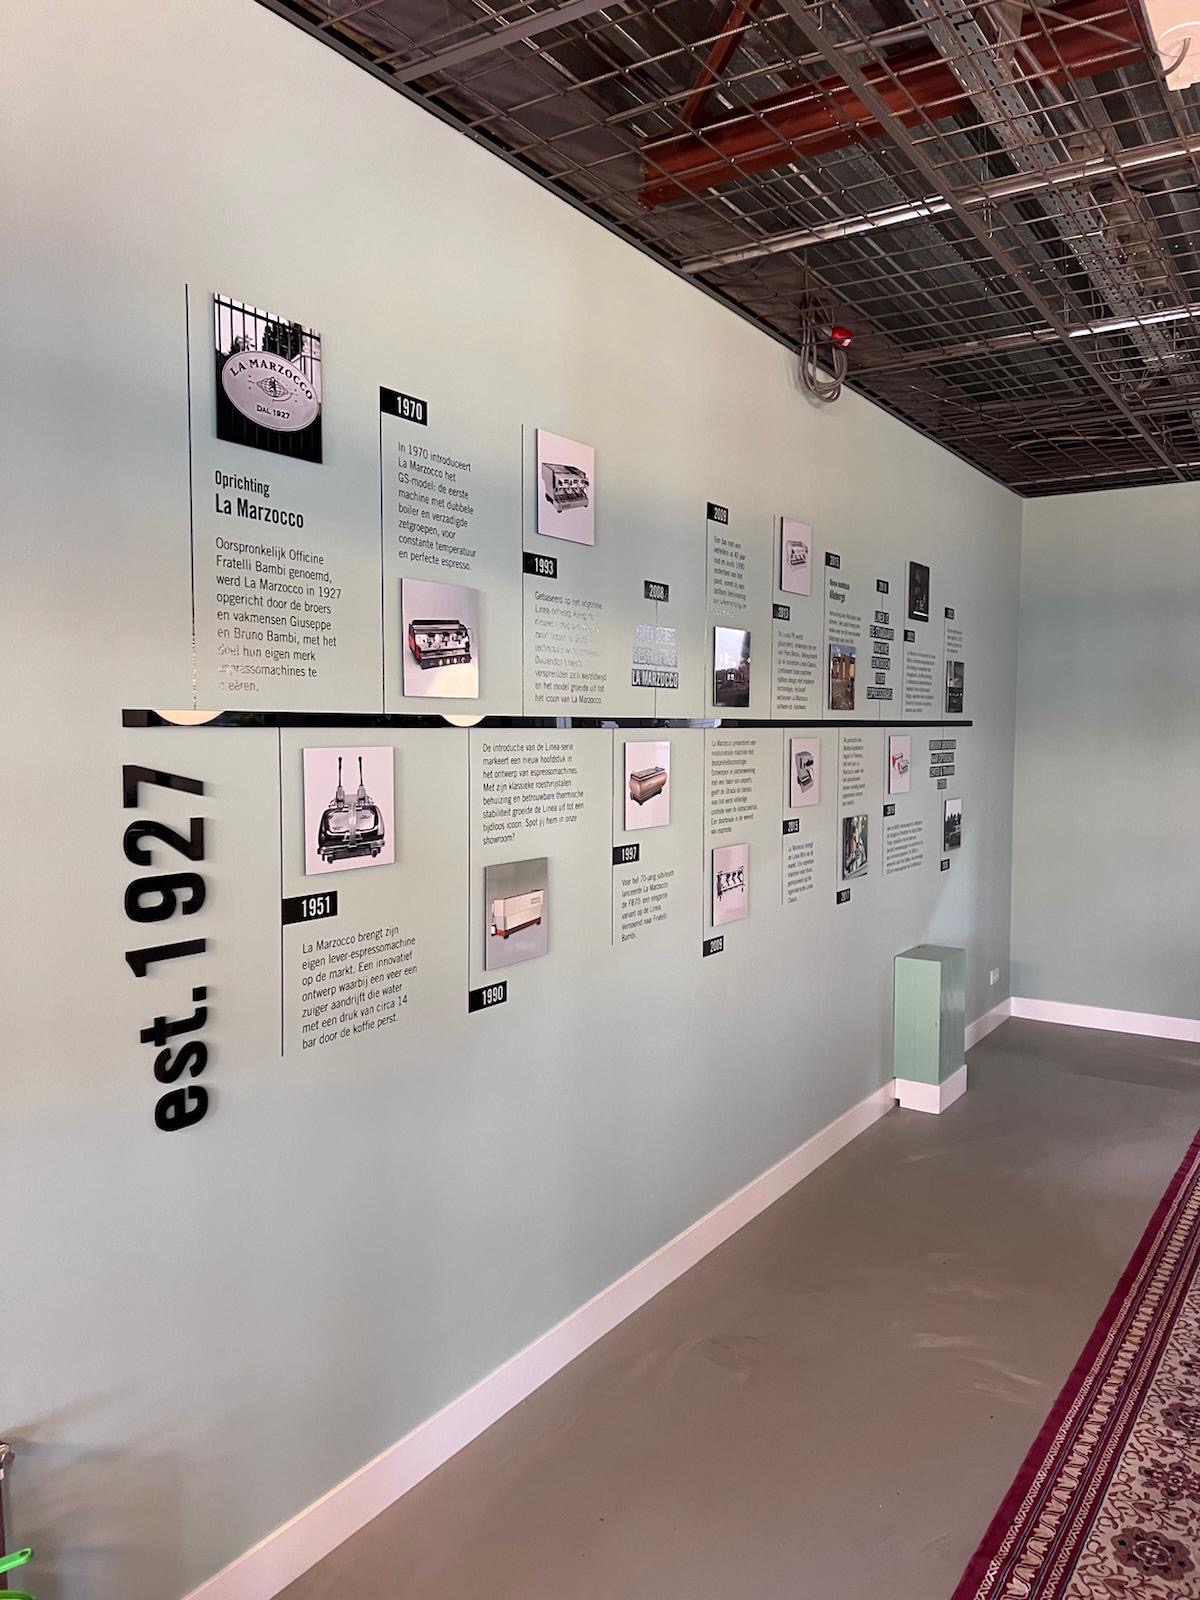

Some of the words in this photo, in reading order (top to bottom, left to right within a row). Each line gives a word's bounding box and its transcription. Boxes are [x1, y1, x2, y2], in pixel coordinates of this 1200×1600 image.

[229, 362, 247, 376] LA
[249, 358, 314, 400] MARZOCCO
[256, 404, 272, 416] DAL
[272, 409, 290, 420] 1927
[396, 396, 423, 421] 1970
[398, 440, 406, 453] In
[408, 444, 428, 460] 1970
[430, 451, 472, 472] introduceert
[398, 456, 408, 469] La
[410, 460, 443, 478] Marzocco
[445, 470, 456, 482] het
[215, 470, 270, 498] Oprichting
[438, 483, 447, 494] de
[448, 488, 469, 500] eerste
[215, 493, 232, 516] La
[237, 497, 304, 528] Marzocco
[398, 489, 430, 504] machine
[432, 498, 445, 508] met
[446, 501, 474, 515] dubbele
[398, 502, 419, 516] boiler
[421, 510, 430, 519] en
[432, 513, 468, 528] verzadigde
[442, 530, 456, 539] voor
[216, 536, 286, 561] Oorspronkelijk
[289, 549, 324, 565] Officine
[398, 536, 434, 550] constante
[436, 541, 476, 558] temperatuur
[398, 550, 408, 559] en
[410, 552, 440, 565] perfecte
[216, 554, 252, 571] Fratelli
[255, 560, 286, 576] Bambi
[289, 568, 332, 584] genoemd,
[534, 557, 554, 575] 1993
[216, 575, 240, 587] werd
[244, 576, 256, 589] La
[260, 578, 304, 596] Marzocco
[306, 585, 315, 597] in
[318, 586, 342, 600] 1927
[216, 592, 264, 607] opgericht
[266, 599, 288, 610] door
[290, 601, 302, 612] de
[304, 601, 332, 615] broers
[217, 610, 230, 621] en
[233, 612, 287, 626] vakmensen
[290, 615, 332, 632] Giuseppe
[217, 628, 230, 639] en
[234, 627, 264, 642] Bruno
[266, 630, 300, 646] Bambi,
[303, 634, 320, 647] met
[323, 636, 337, 648] het
[243, 646, 262, 658] hun
[265, 647, 290, 662] eigen
[294, 650, 316, 662] merk
[308, 667, 318, 678] te
[632, 669, 640, 686] LA
[642, 670, 678, 688] MARZOCCO
[554, 683, 570, 692] model
[546, 694, 560, 702] icoon
[572, 696, 578, 704] La
[482, 743, 492, 752] De
[492, 743, 524, 752] introductie
[526, 744, 536, 752] van
[537, 743, 544, 752] de
[482, 756, 509, 766] markeert
[510, 757, 521, 765] een
[540, 754, 566, 764] hoofdstuk
[567, 755, 573, 763] in
[482, 770, 493, 779] het
[494, 770, 518, 779] ontwerp
[520, 770, 529, 778] van
[483, 782, 495, 792] Met
[496, 782, 508, 793] zijn
[508, 780, 534, 790] klassieke
[482, 796, 512, 806] behuizing
[514, 796, 521, 804] en
[522, 792, 555, 803] betrouwbare
[482, 808, 512, 819] stabiliteit
[512, 807, 533, 818] groeide
[542, 804, 558, 813] Linea
[574, 802, 584, 810] een
[482, 822, 506, 833] tijdloos
[525, 818, 538, 828] Spot
[546, 816, 558, 825] hem
[566, 814, 578, 822] onze
[482, 832, 516, 846] showroom?
[622, 846, 637, 861] 1997
[301, 895, 330, 918] 1951
[302, 943, 314, 954] La
[316, 935, 356, 952] Marzocco
[358, 928, 384, 942] brengt
[385, 926, 400, 938] zijn
[302, 957, 326, 971] eigen
[328, 937, 416, 964] lever-espressomachine
[302, 975, 314, 987] op
[316, 972, 327, 983] de
[329, 965, 356, 980] markt.
[358, 961, 374, 973] Een
[376, 950, 414, 968] innovatief
[302, 985, 337, 1002] ontwerp
[339, 978, 368, 992] waarbij
[370, 973, 385, 985] een
[386, 968, 402, 980] veer
[404, 965, 418, 976] een
[302, 1004, 329, 1018] zuiger
[330, 992, 366, 1010] aandrijft
[368, 989, 380, 1001] die
[382, 983, 403, 996] water
[482, 984, 504, 1006] 1990
[302, 1020, 319, 1034] met
[321, 1016, 338, 1028] een
[340, 1009, 358, 1023] druk
[360, 1005, 374, 1017] van
[376, 999, 396, 1012] circa
[398, 994, 408, 1006] 14
[302, 1038, 316, 1050] bar
[318, 1031, 338, 1045] door
[340, 1027, 351, 1038] de
[353, 1020, 375, 1034] koffie
